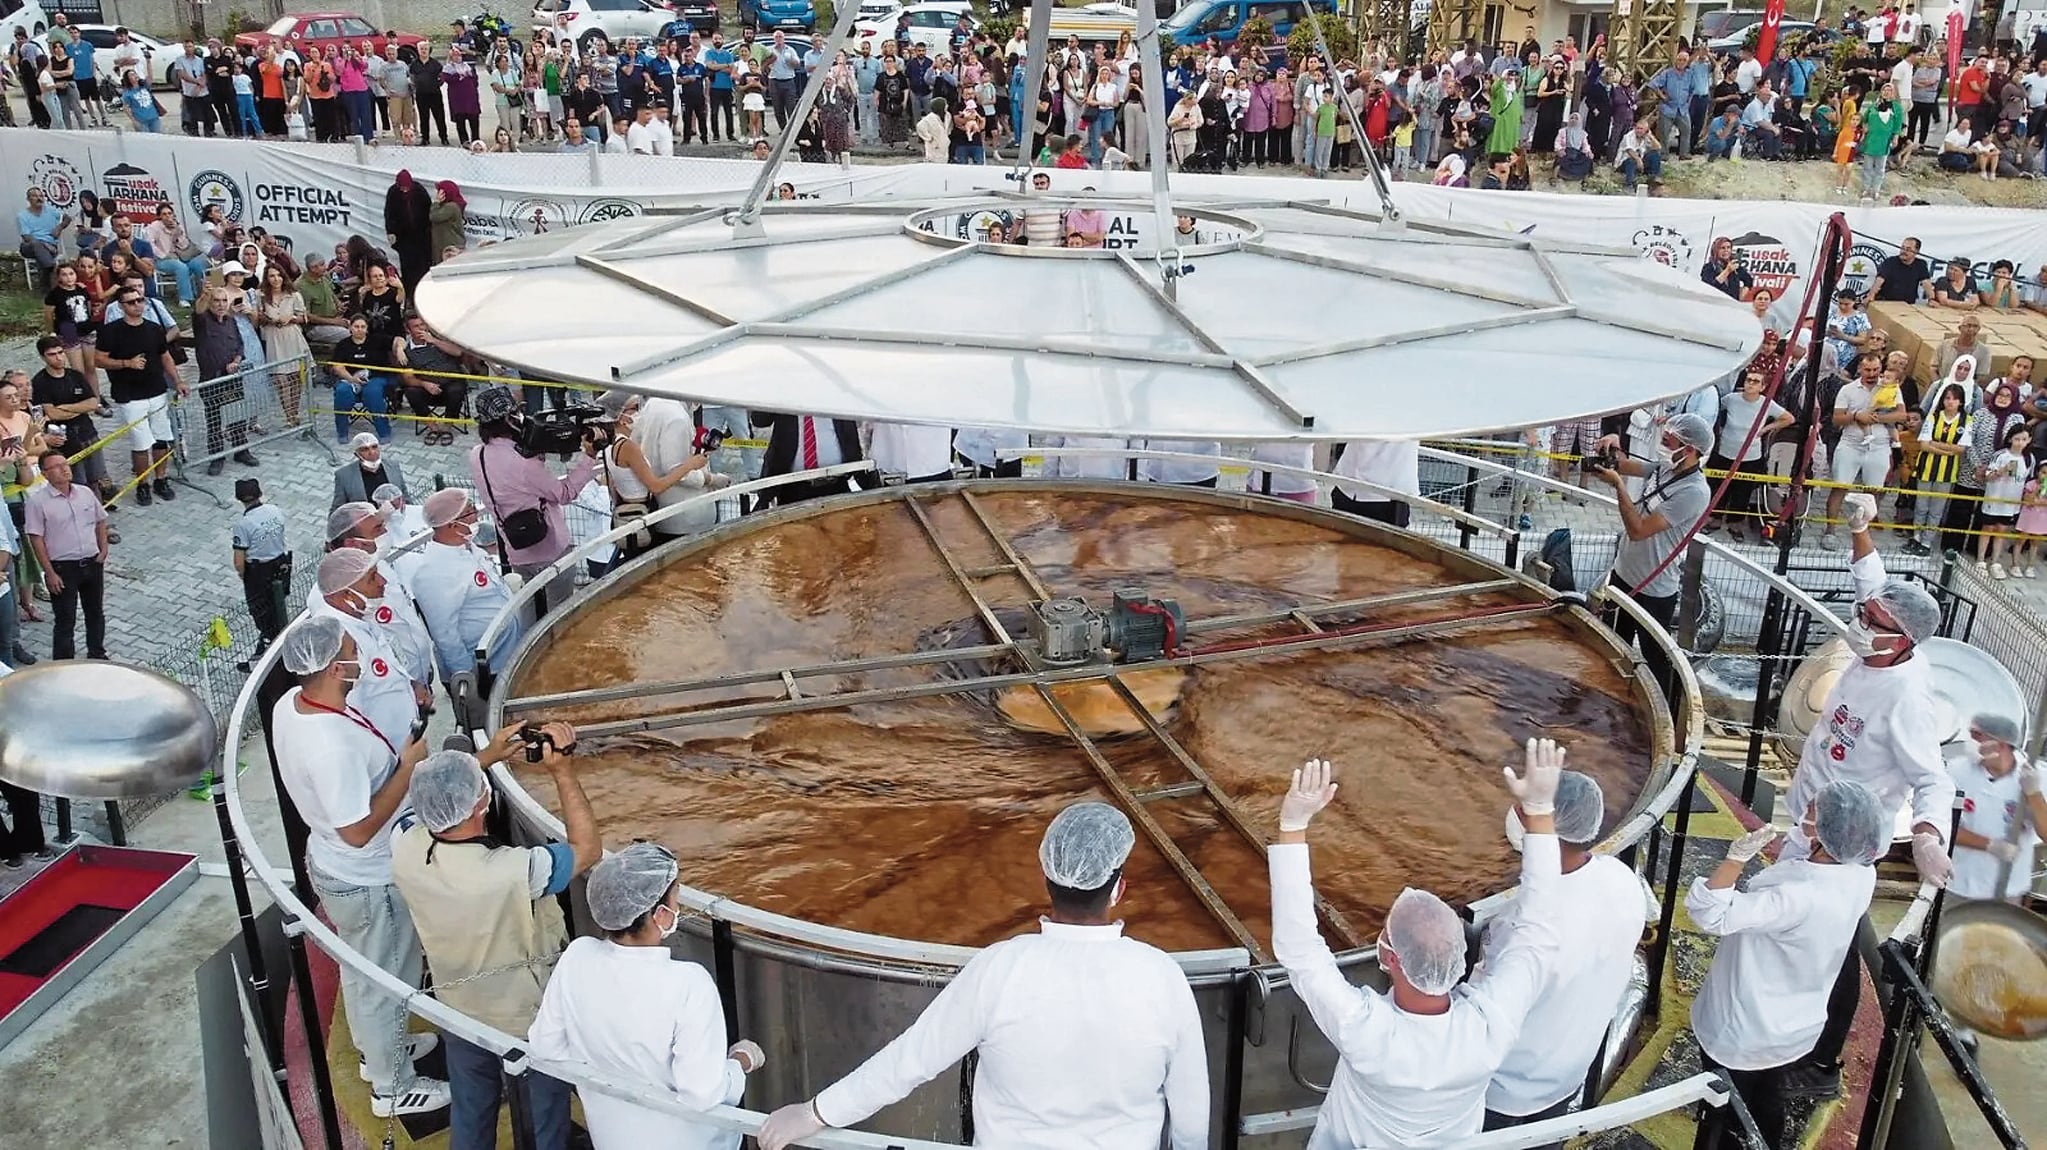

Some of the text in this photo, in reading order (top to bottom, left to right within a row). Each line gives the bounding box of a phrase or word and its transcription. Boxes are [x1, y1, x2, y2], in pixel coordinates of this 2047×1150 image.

[194, 173, 234, 190] GUINNESS
[103, 182, 169, 202] TARHANA
[256, 184, 350, 206] OFFICIAL
[116, 200, 157, 214] festiva
[260, 205, 351, 226] ATTEMPT
[1740, 260, 1796, 275] RHANA
[1753, 275, 1786, 289] ivali
